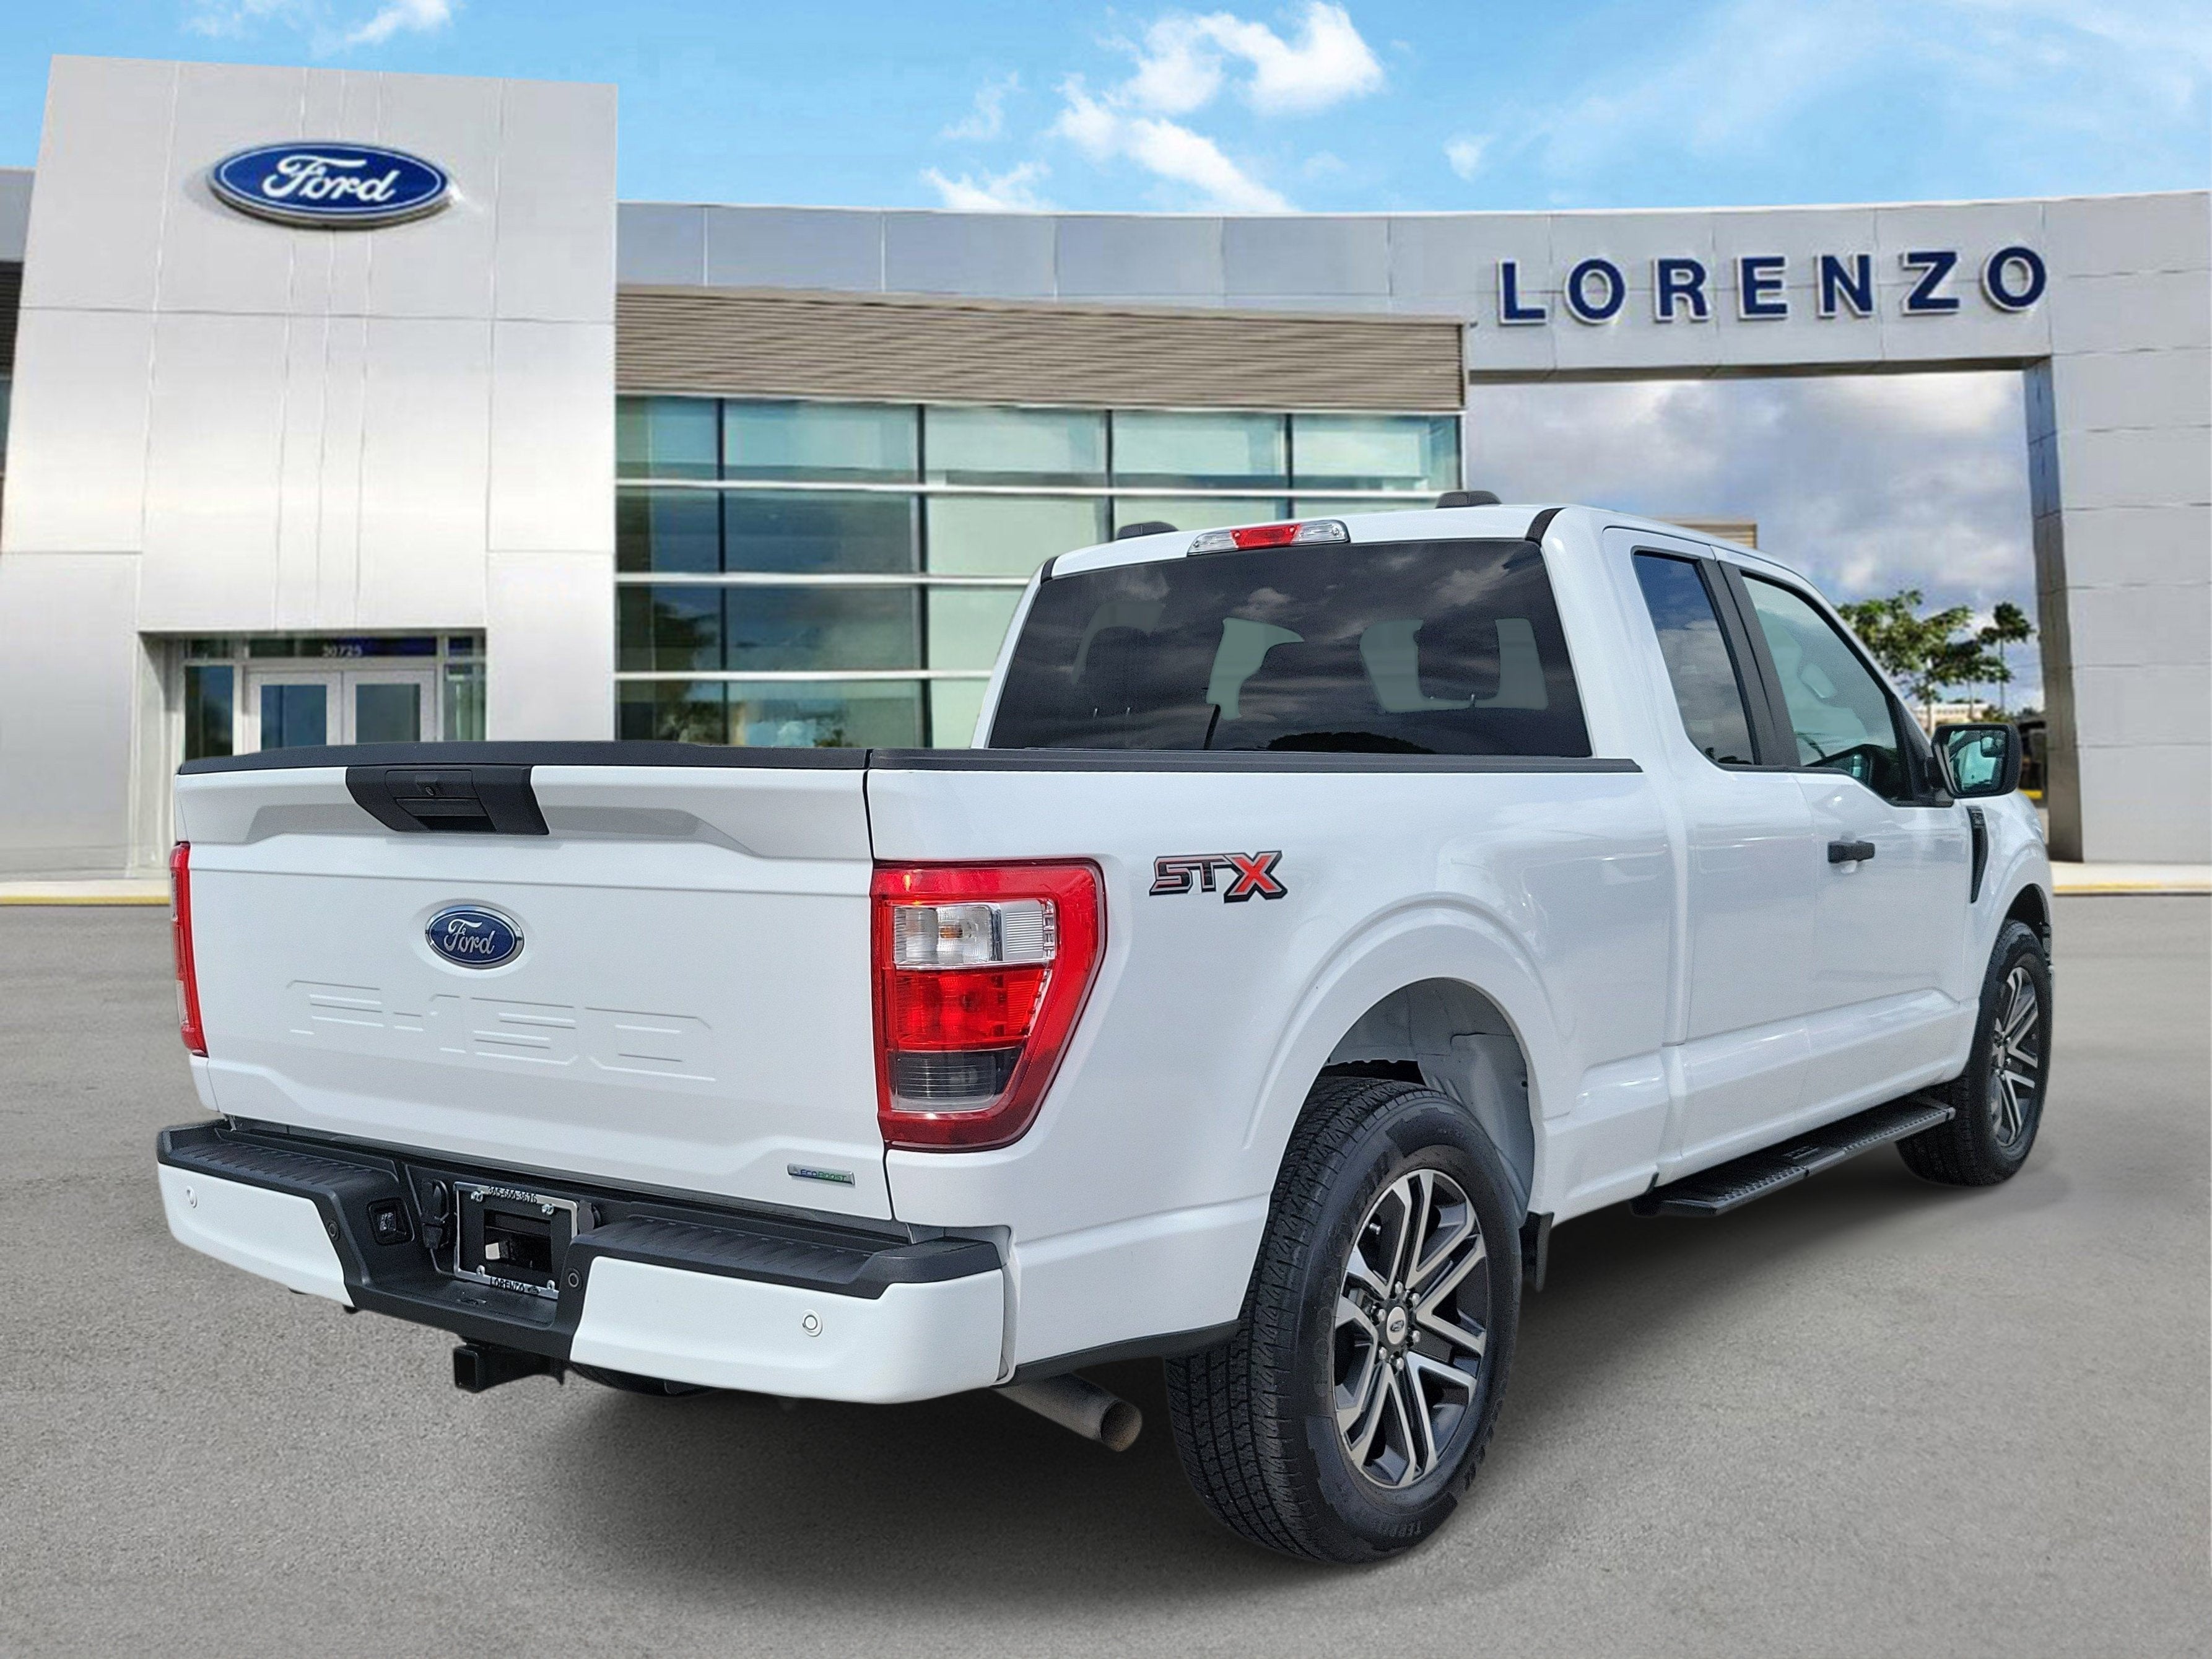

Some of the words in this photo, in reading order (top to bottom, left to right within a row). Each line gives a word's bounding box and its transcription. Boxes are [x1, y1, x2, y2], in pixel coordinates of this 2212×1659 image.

[262, 154, 401, 202] Ford
[1497, 246, 2047, 328] LORENZO
[1149, 850, 1289, 904] STX
[443, 918, 496, 954] Ford
[490, 1276, 525, 1294] LORENZO
